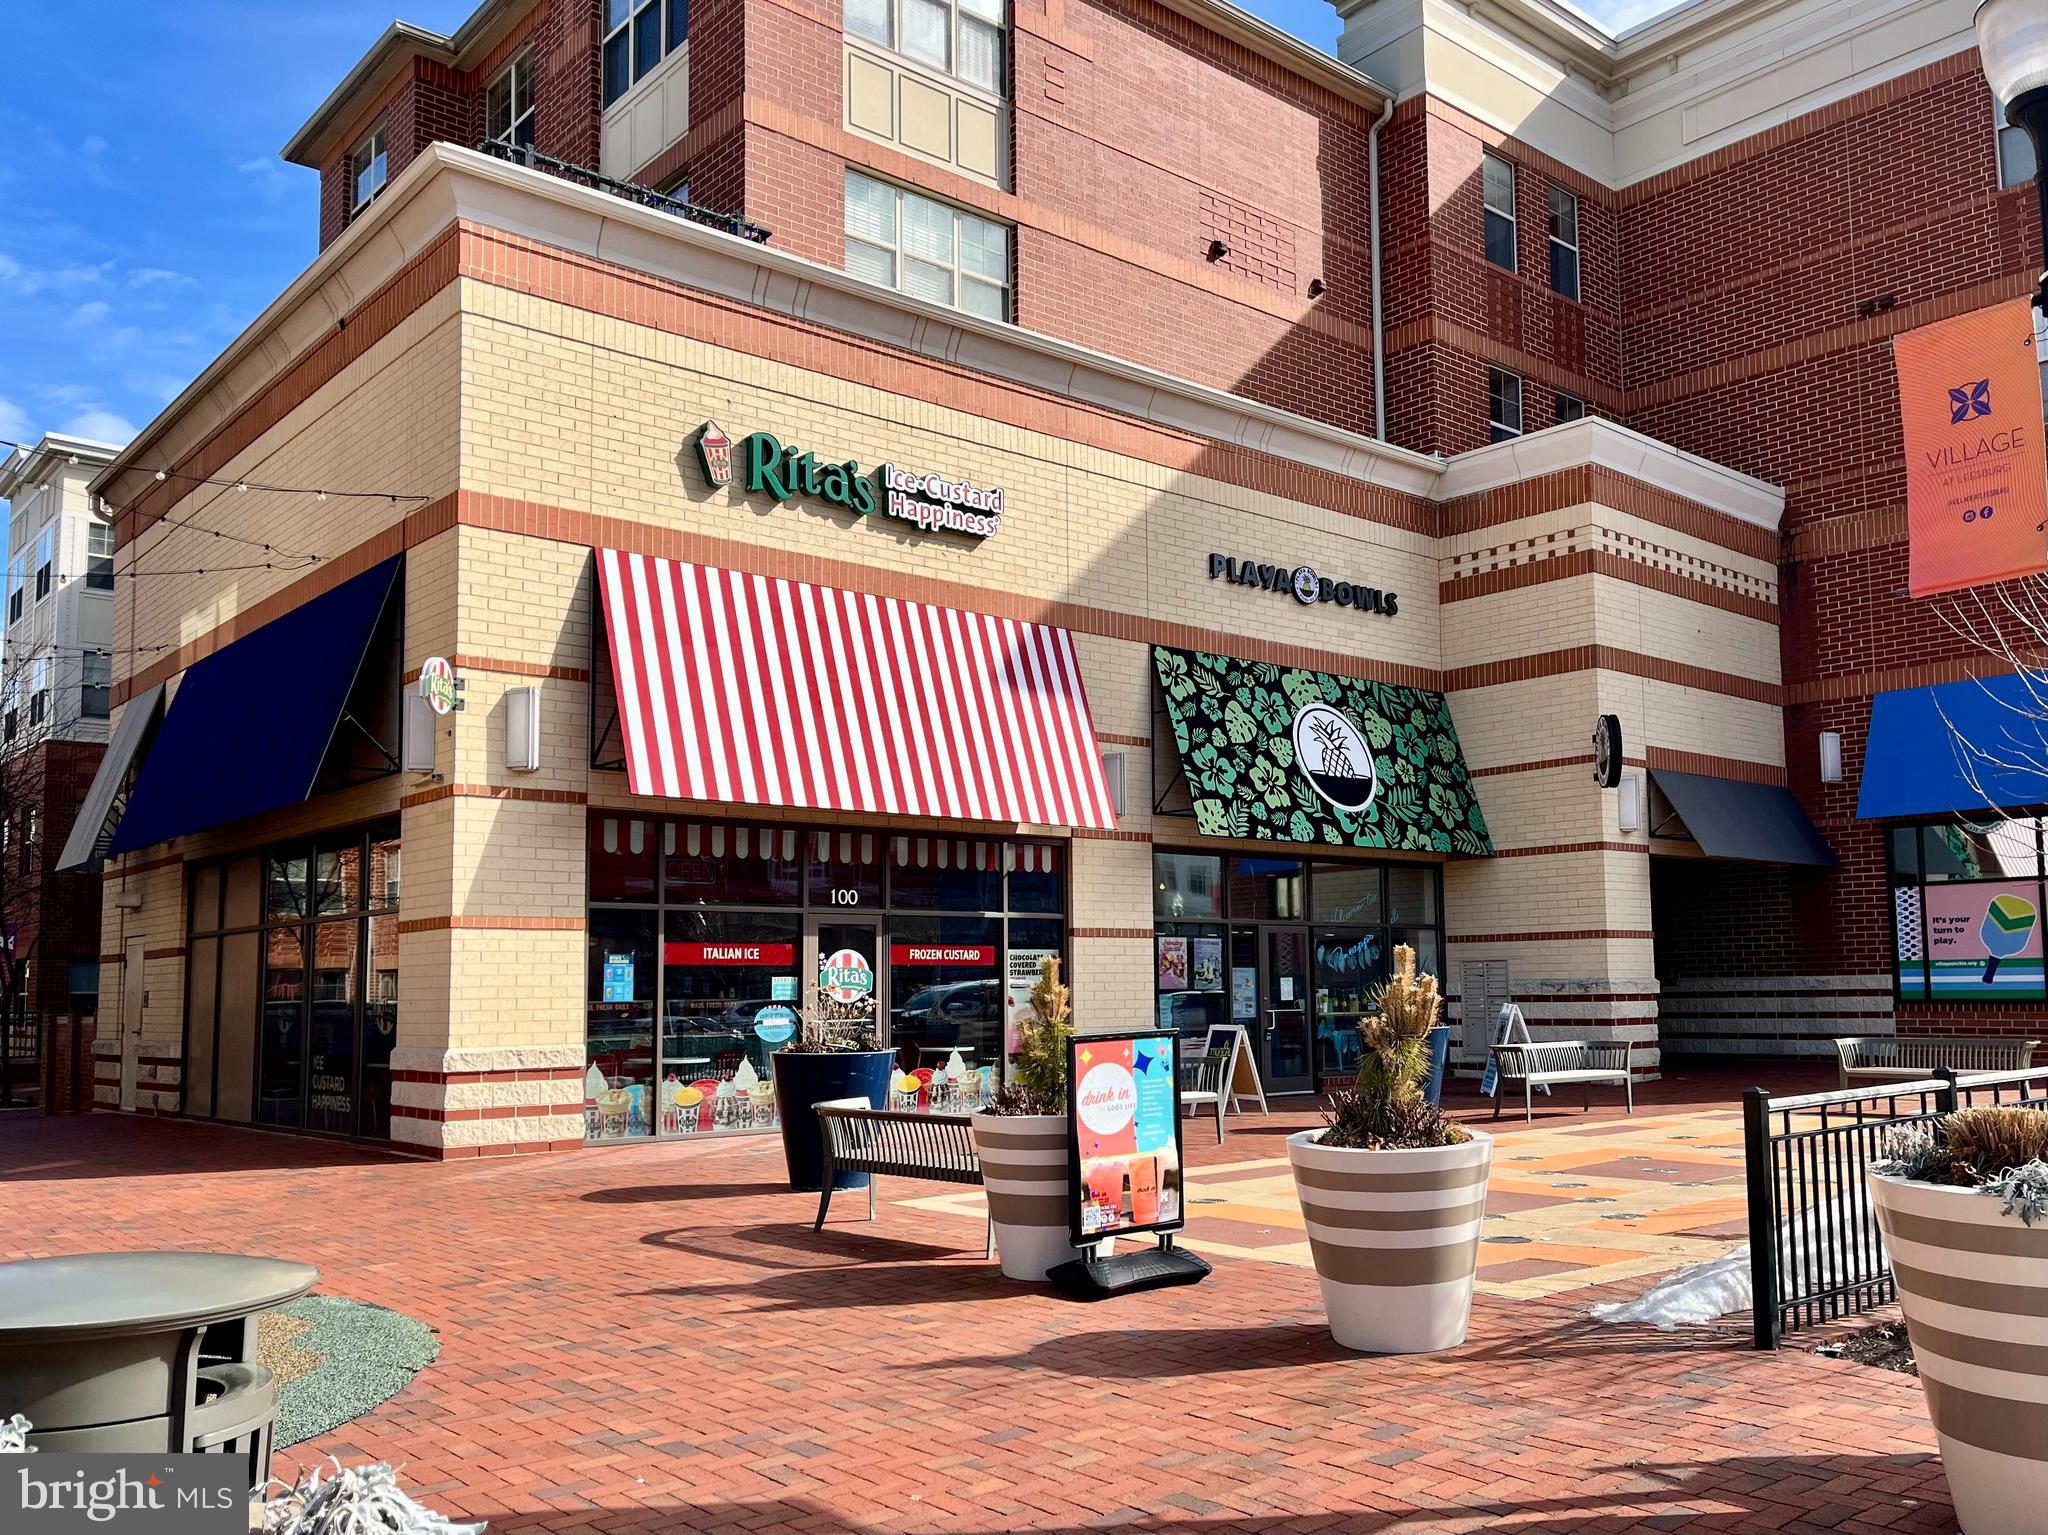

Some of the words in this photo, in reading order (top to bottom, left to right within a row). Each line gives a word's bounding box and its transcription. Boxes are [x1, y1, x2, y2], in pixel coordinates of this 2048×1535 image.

[1926, 426, 2025, 469] VILLAGE
[745, 431, 876, 515] Rita's
[1942, 476, 1954, 487] AT
[1956, 462, 2012, 484] LEESBURG
[1208, 553, 1292, 594] PLAYA
[1319, 577, 1399, 616] BOWLS
[431, 672, 453, 699] Rita's
[669, 862, 711, 881] OPEN
[830, 889, 859, 905] 100
[1932, 916, 1947, 924] It's
[1948, 916, 1971, 925] your
[1933, 936, 1957, 945] play.
[703, 947, 742, 960] ITALIAN
[744, 948, 760, 960] ICE
[909, 949, 942, 960] FROZEN
[943, 949, 980, 961] CUSTARD
[1009, 961, 1037, 969] COVERED
[1009, 969, 1044, 977] STRAWBER
[827, 967, 868, 986] Rita's
[313, 1055, 325, 1071] ICE
[312, 1075, 345, 1092] CUSTARD
[311, 1094, 351, 1113] HAPPINESS
[1081, 1086, 1115, 1107] drink
[1117, 1086, 1131, 1101] in
